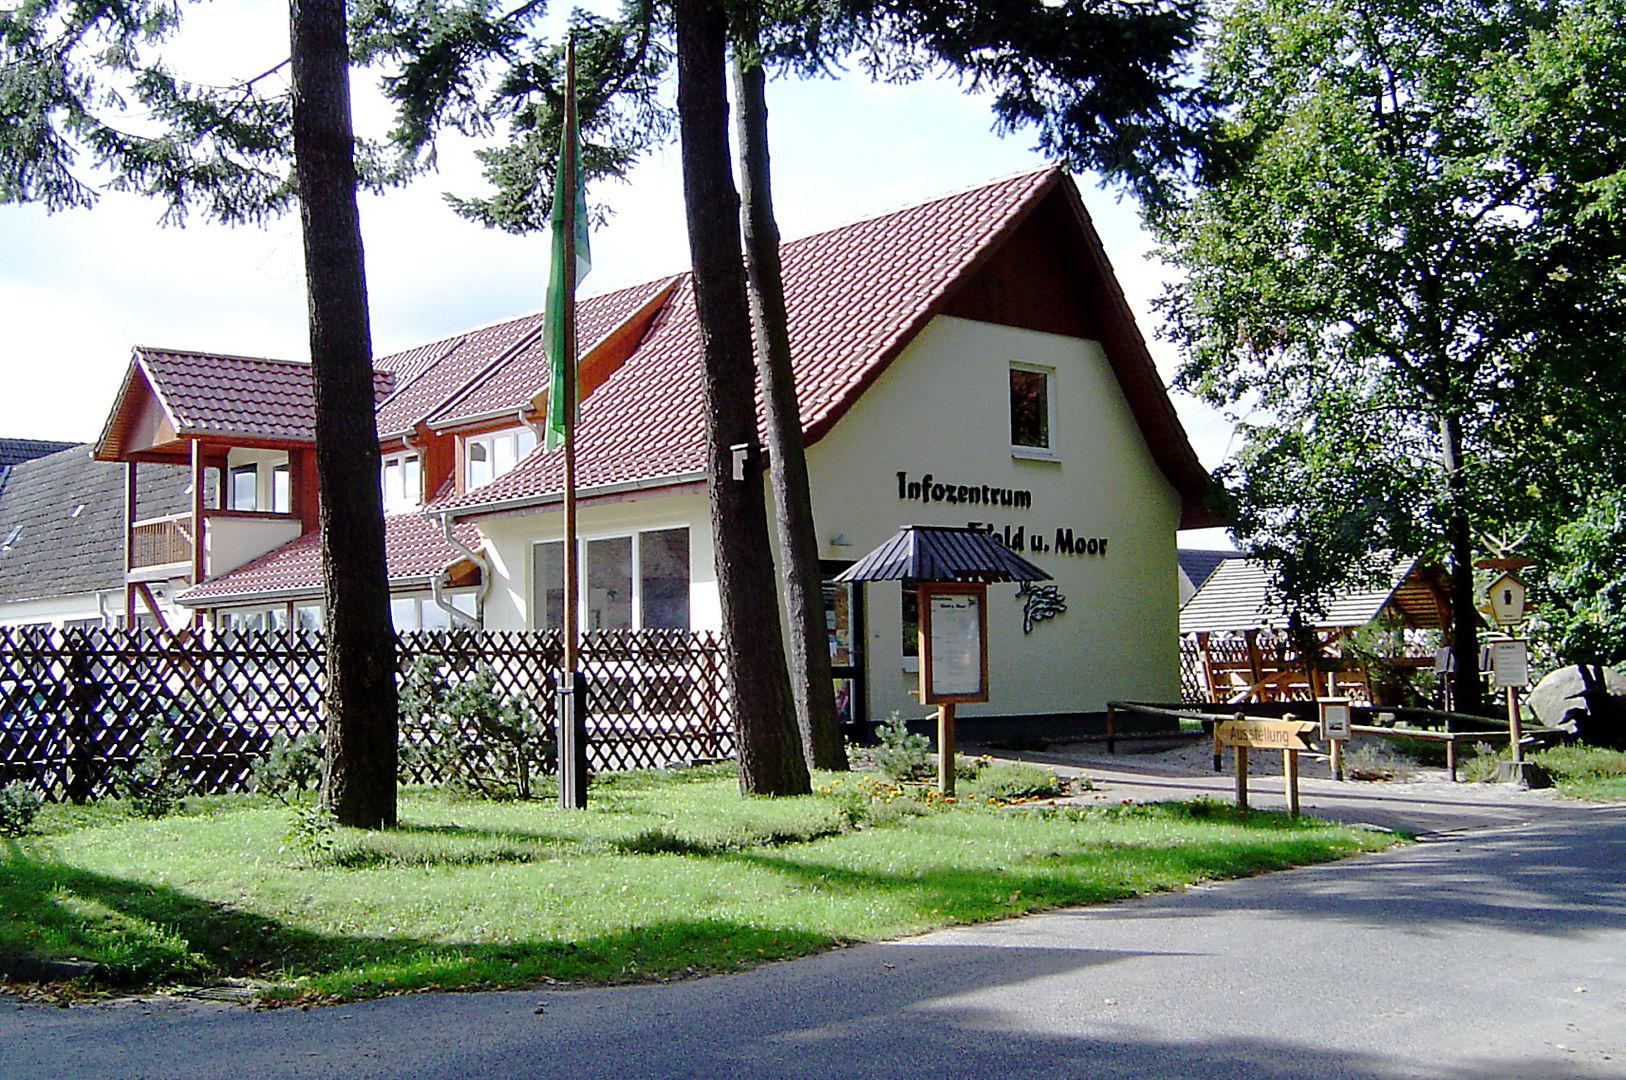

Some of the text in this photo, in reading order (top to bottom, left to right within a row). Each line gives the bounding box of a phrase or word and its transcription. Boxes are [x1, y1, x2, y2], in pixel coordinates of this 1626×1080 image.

[896, 471, 1032, 508] Infozentrum
[967, 521, 1108, 555] ald u. Moor
[1230, 725, 1289, 747] Ausstellung
